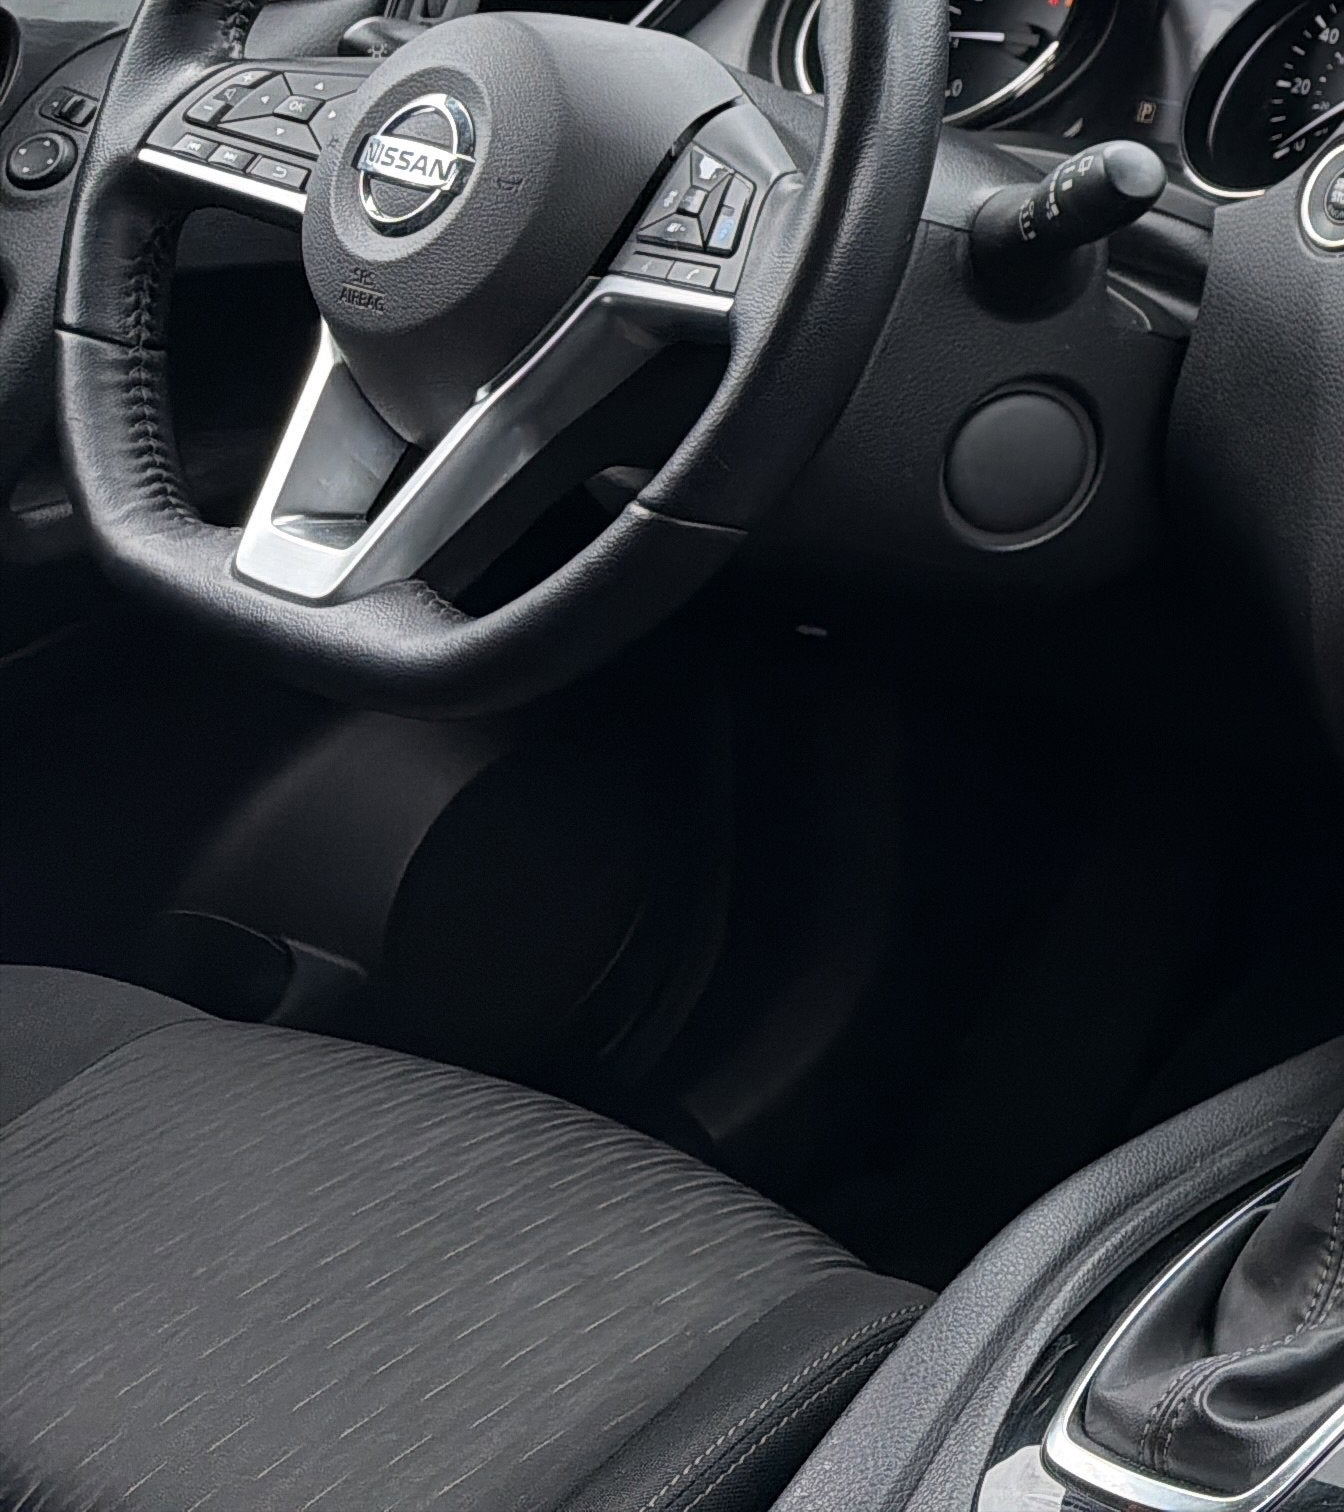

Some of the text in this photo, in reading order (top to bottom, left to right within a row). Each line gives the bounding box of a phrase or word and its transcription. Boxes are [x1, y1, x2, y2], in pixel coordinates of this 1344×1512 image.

[1319, 27, 1340, 44] 40
[1291, 77, 1311, 95] 20
[364, 141, 457, 181] NISSAN
